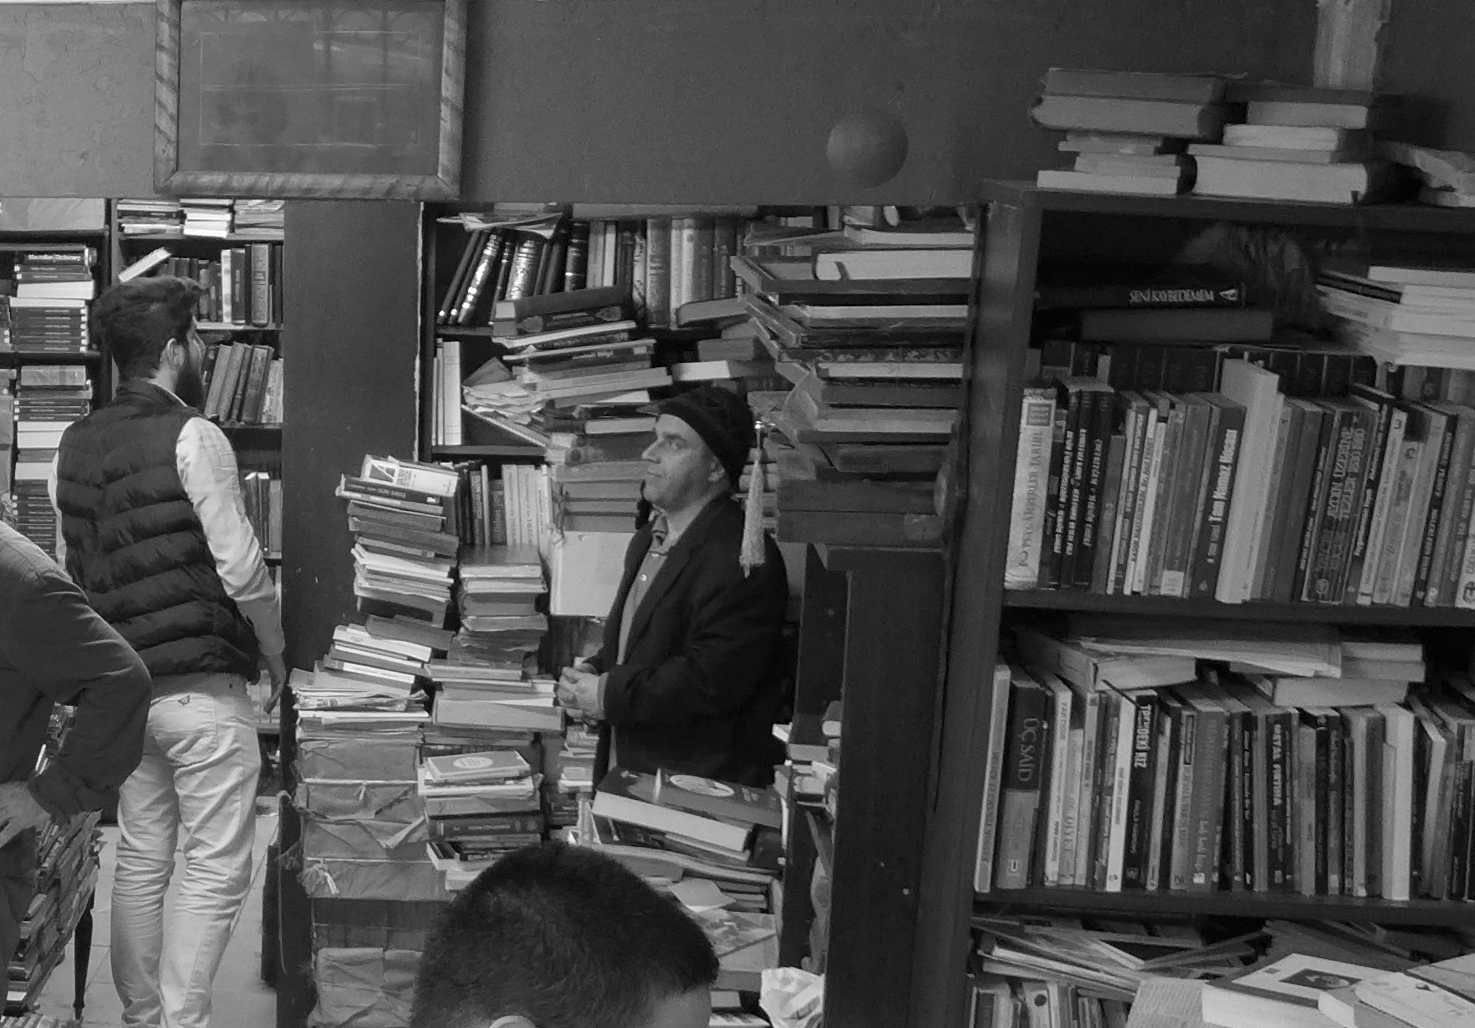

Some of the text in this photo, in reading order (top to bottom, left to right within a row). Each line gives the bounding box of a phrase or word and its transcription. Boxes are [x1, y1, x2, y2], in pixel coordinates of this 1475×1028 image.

[1016, 718, 1037, 782] ÜÇ SAİD
[1272, 723, 1281, 806] METAL FIRTINA
